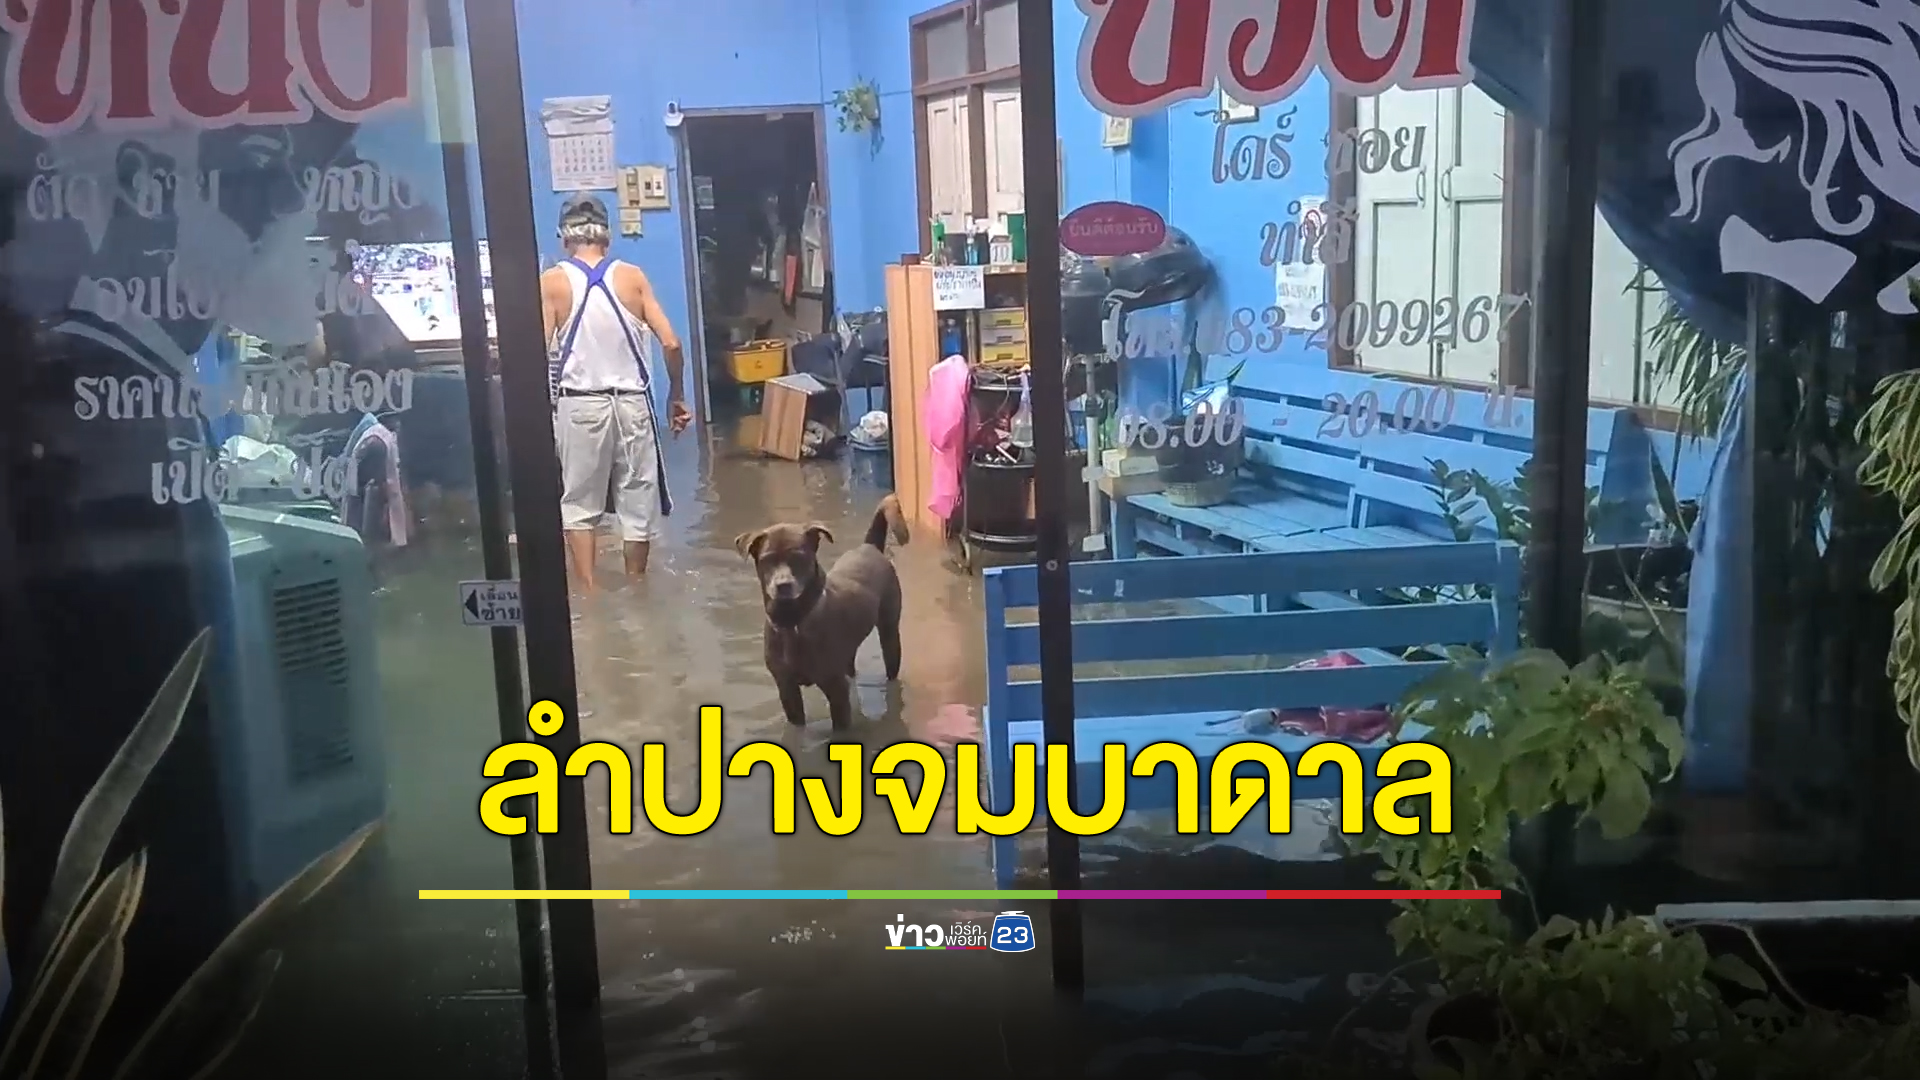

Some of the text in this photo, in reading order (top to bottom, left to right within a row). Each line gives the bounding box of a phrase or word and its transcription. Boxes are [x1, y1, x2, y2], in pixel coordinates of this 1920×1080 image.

[1194, 105, 1297, 184] ไดร์
[1260, 199, 1360, 267] ทำสี
[1112, 397, 1246, 449] 08.00
[1317, 385, 1455, 438] 20.00
[152, 436, 238, 504] เปิด
[481, 601, 521, 620] ซ้าย
